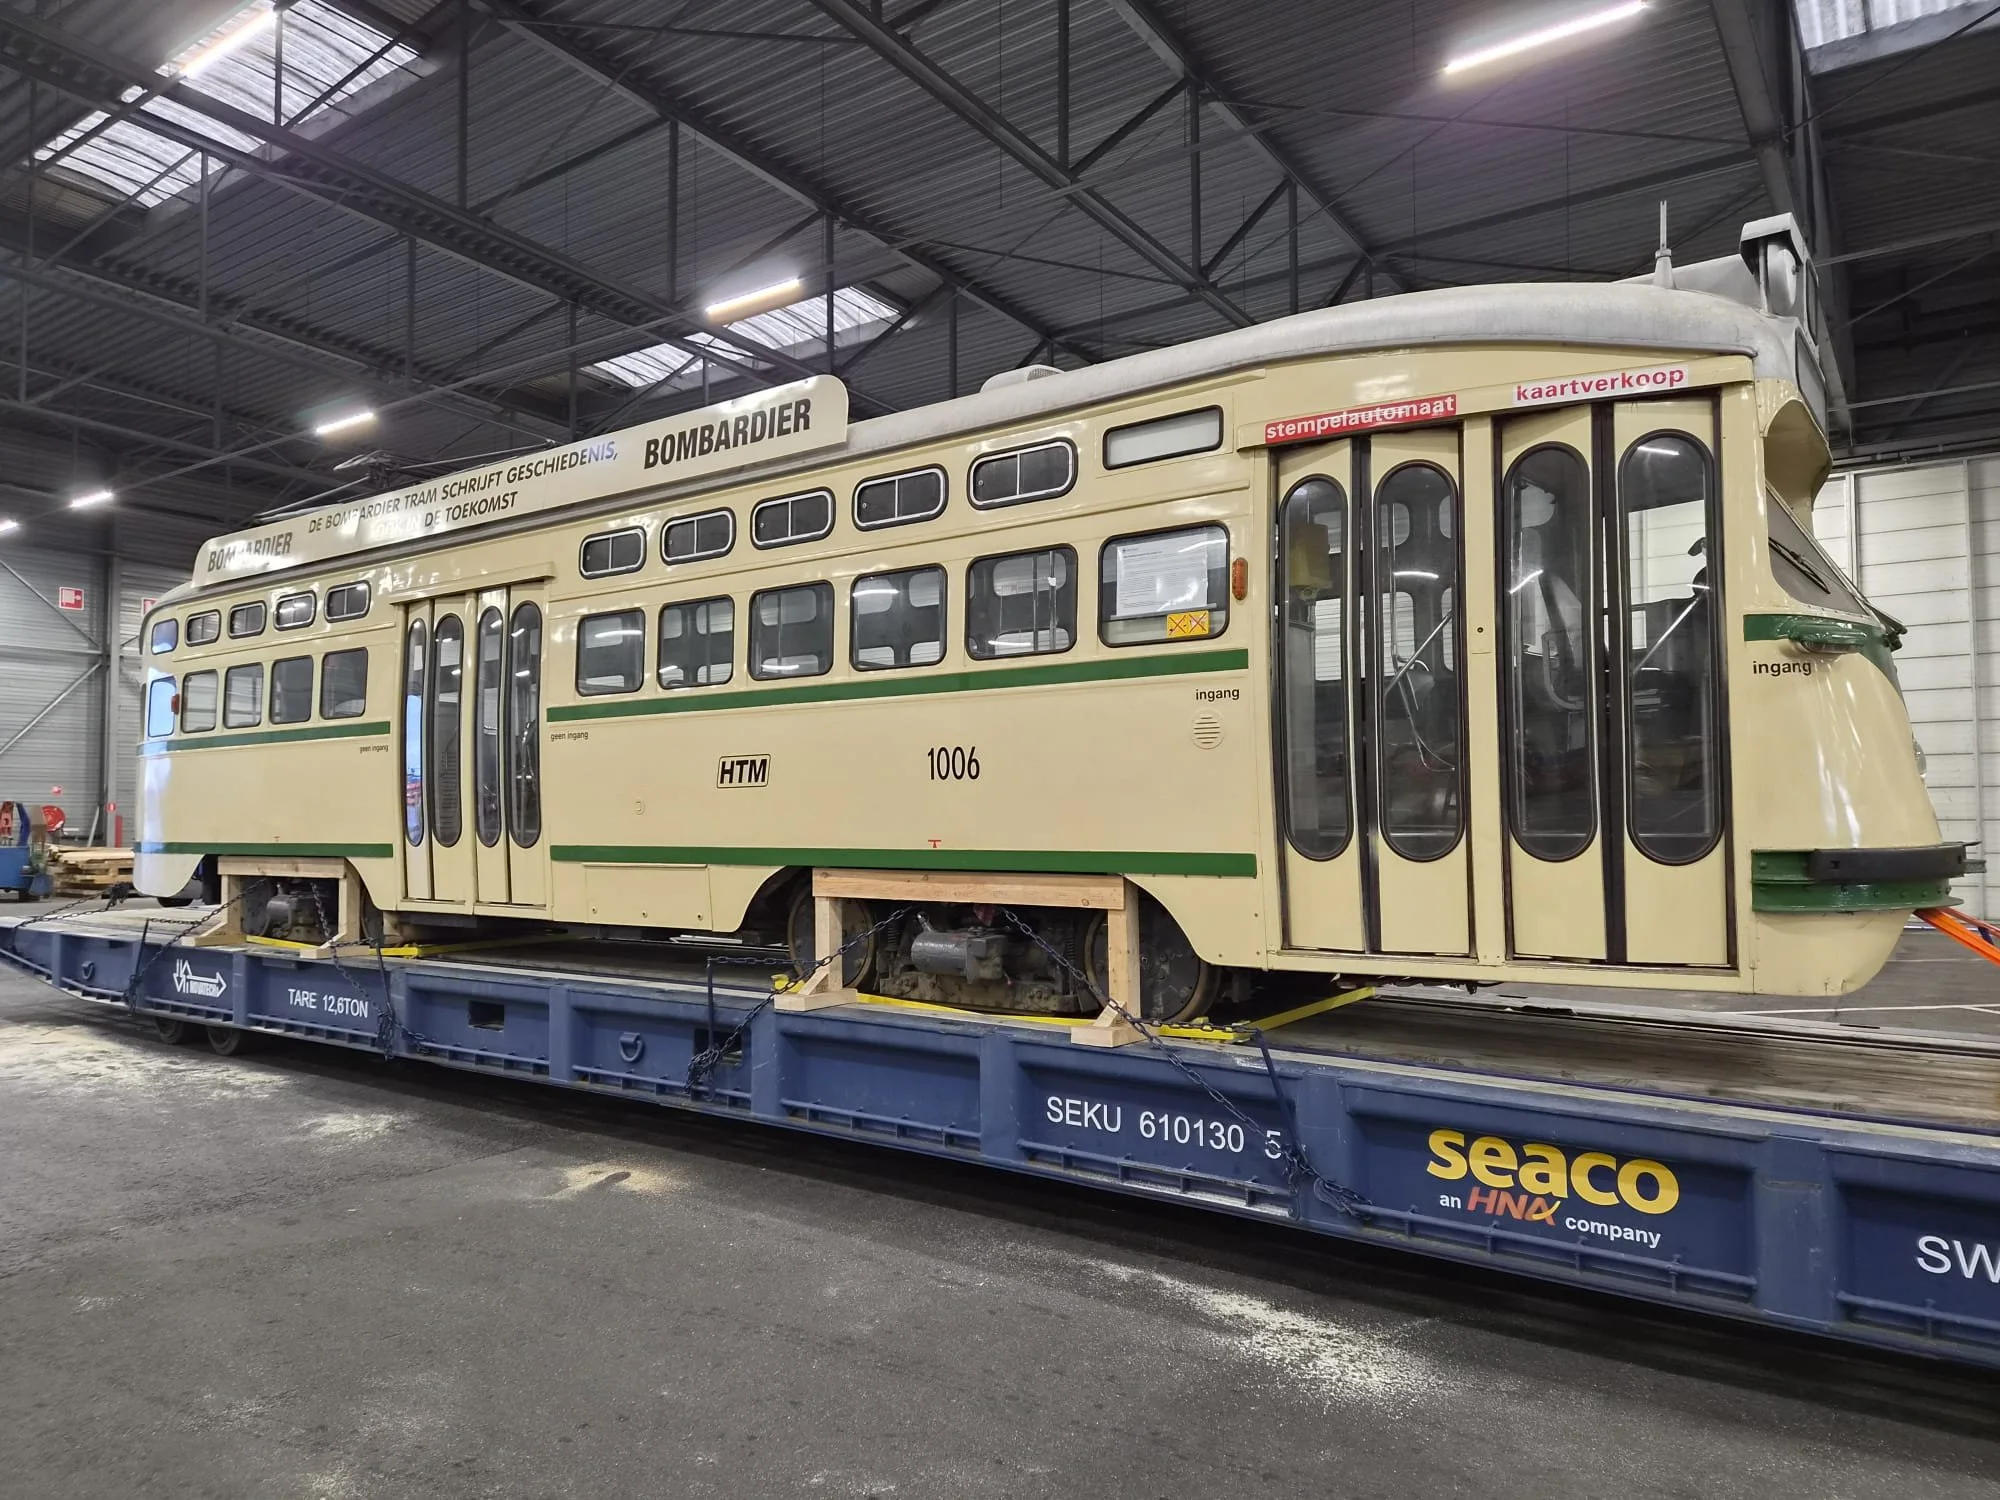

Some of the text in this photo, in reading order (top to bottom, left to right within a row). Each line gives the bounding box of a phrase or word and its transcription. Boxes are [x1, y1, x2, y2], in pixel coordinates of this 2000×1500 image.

[1516, 367, 1685, 402] kaartverkoop
[644, 398, 812, 470] BOMBARDIER
[1266, 398, 1455, 440] stempelautomaat
[308, 519, 323, 534] DE
[404, 487, 438, 510] TRAM
[441, 470, 503, 502] SCHRIJFT
[506, 441, 619, 484] GESCHIEDENIS,
[425, 509, 442, 527] DE
[445, 491, 519, 523] TOEKOMST
[207, 532, 294, 573] BOMARDIER
[1753, 660, 1812, 677] ingang
[1195, 688, 1240, 703] ingang
[550, 731, 589, 742] geen ingang
[719, 758, 768, 785] HTM
[927, 746, 981, 781] 1006
[287, 988, 369, 1019] TARE 12,6TON
[1046, 1096, 1283, 1160] SEKU 610130 5
[1426, 1129, 1680, 1215] seaco
[1439, 1186, 1662, 1249] an HNA company
